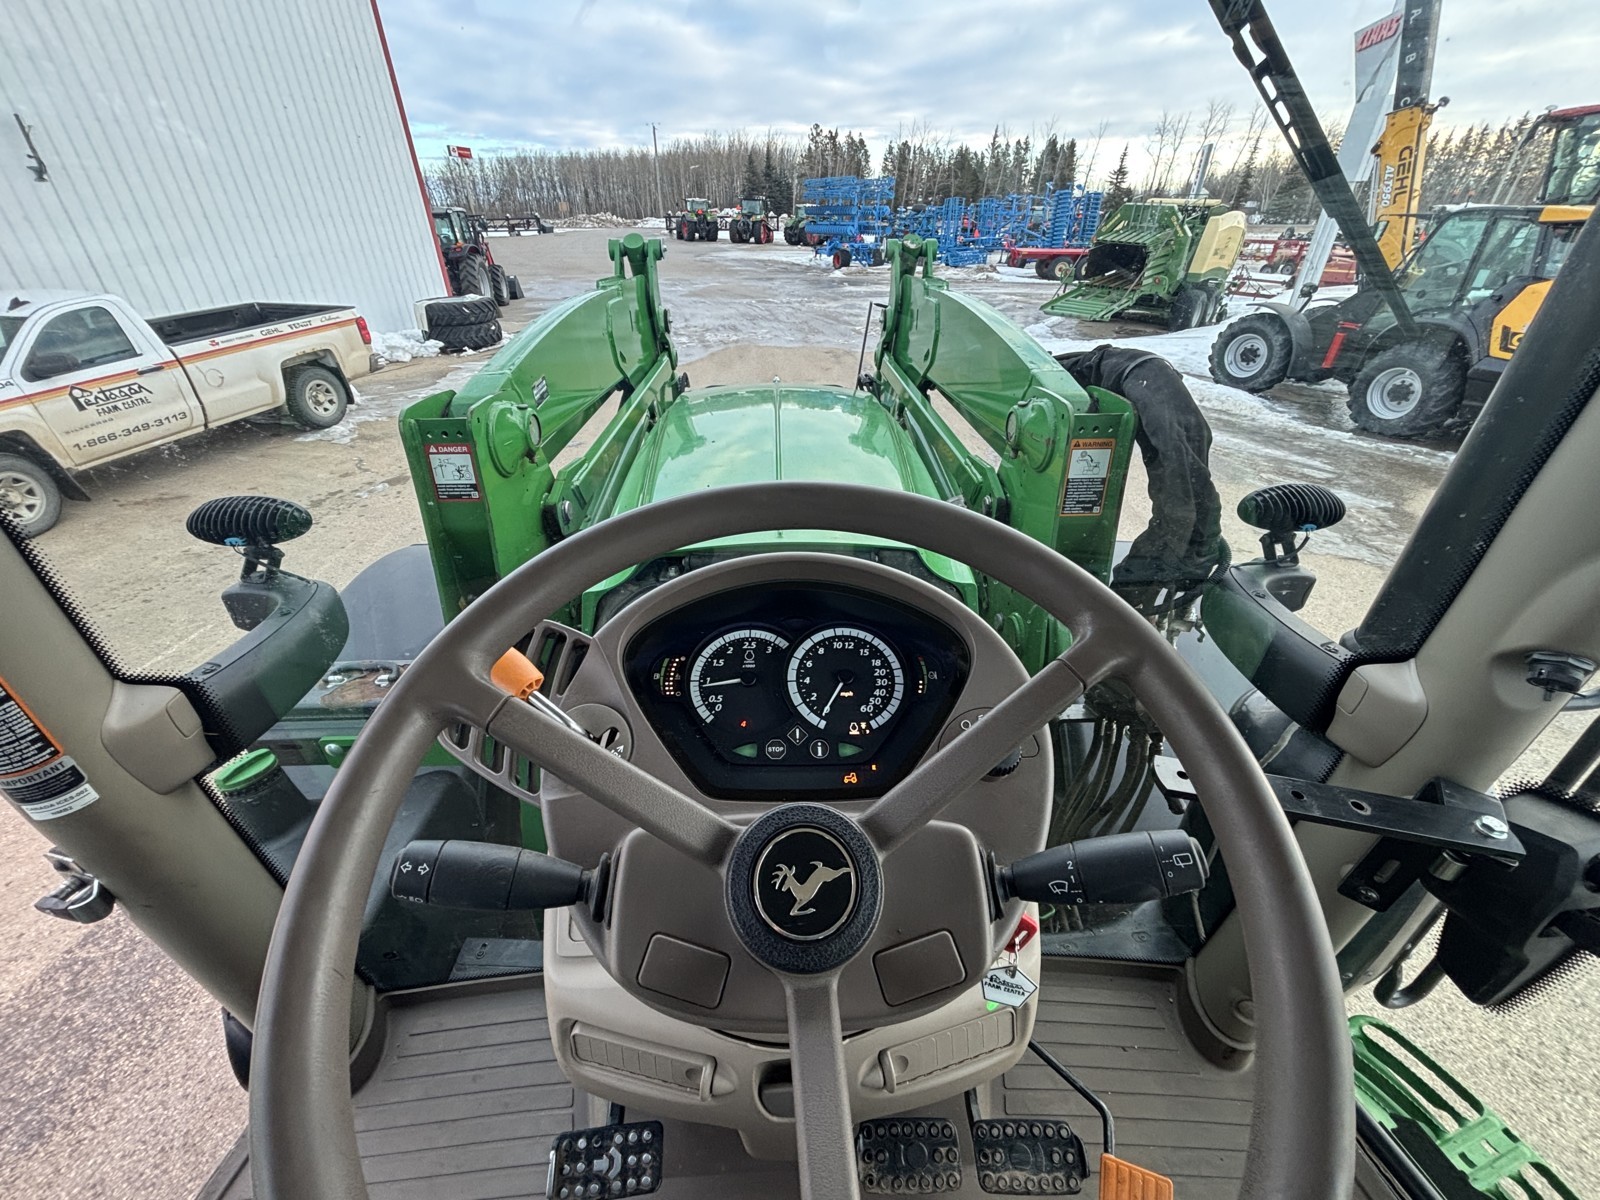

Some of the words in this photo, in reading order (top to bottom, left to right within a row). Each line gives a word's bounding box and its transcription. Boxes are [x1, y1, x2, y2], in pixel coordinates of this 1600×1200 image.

[1356, 14, 1403, 52] CLAAS
[1392, 145, 1413, 205] GEHL
[1381, 164, 1395, 207] ALT950
[72, 411, 188, 452] 1-866-349-3113
[742, 641, 757, 649] 2.5
[832, 641, 843, 649] 10
[844, 641, 855, 649] 12
[726, 646, 734, 654] 2
[765, 646, 772, 654] 3
[817, 647, 825, 655] 8
[712, 659, 725, 667] 1.5
[806, 660, 813, 668] 6
[873, 668, 886, 676] 20
[810, 692, 817, 700] 2
[869, 697, 881, 705] 50
[715, 703, 723, 711] 0
[860, 704, 874, 712] 60
[0, 761, 66, 787] MPORTANT
[1066, 860, 1074, 869] 2
